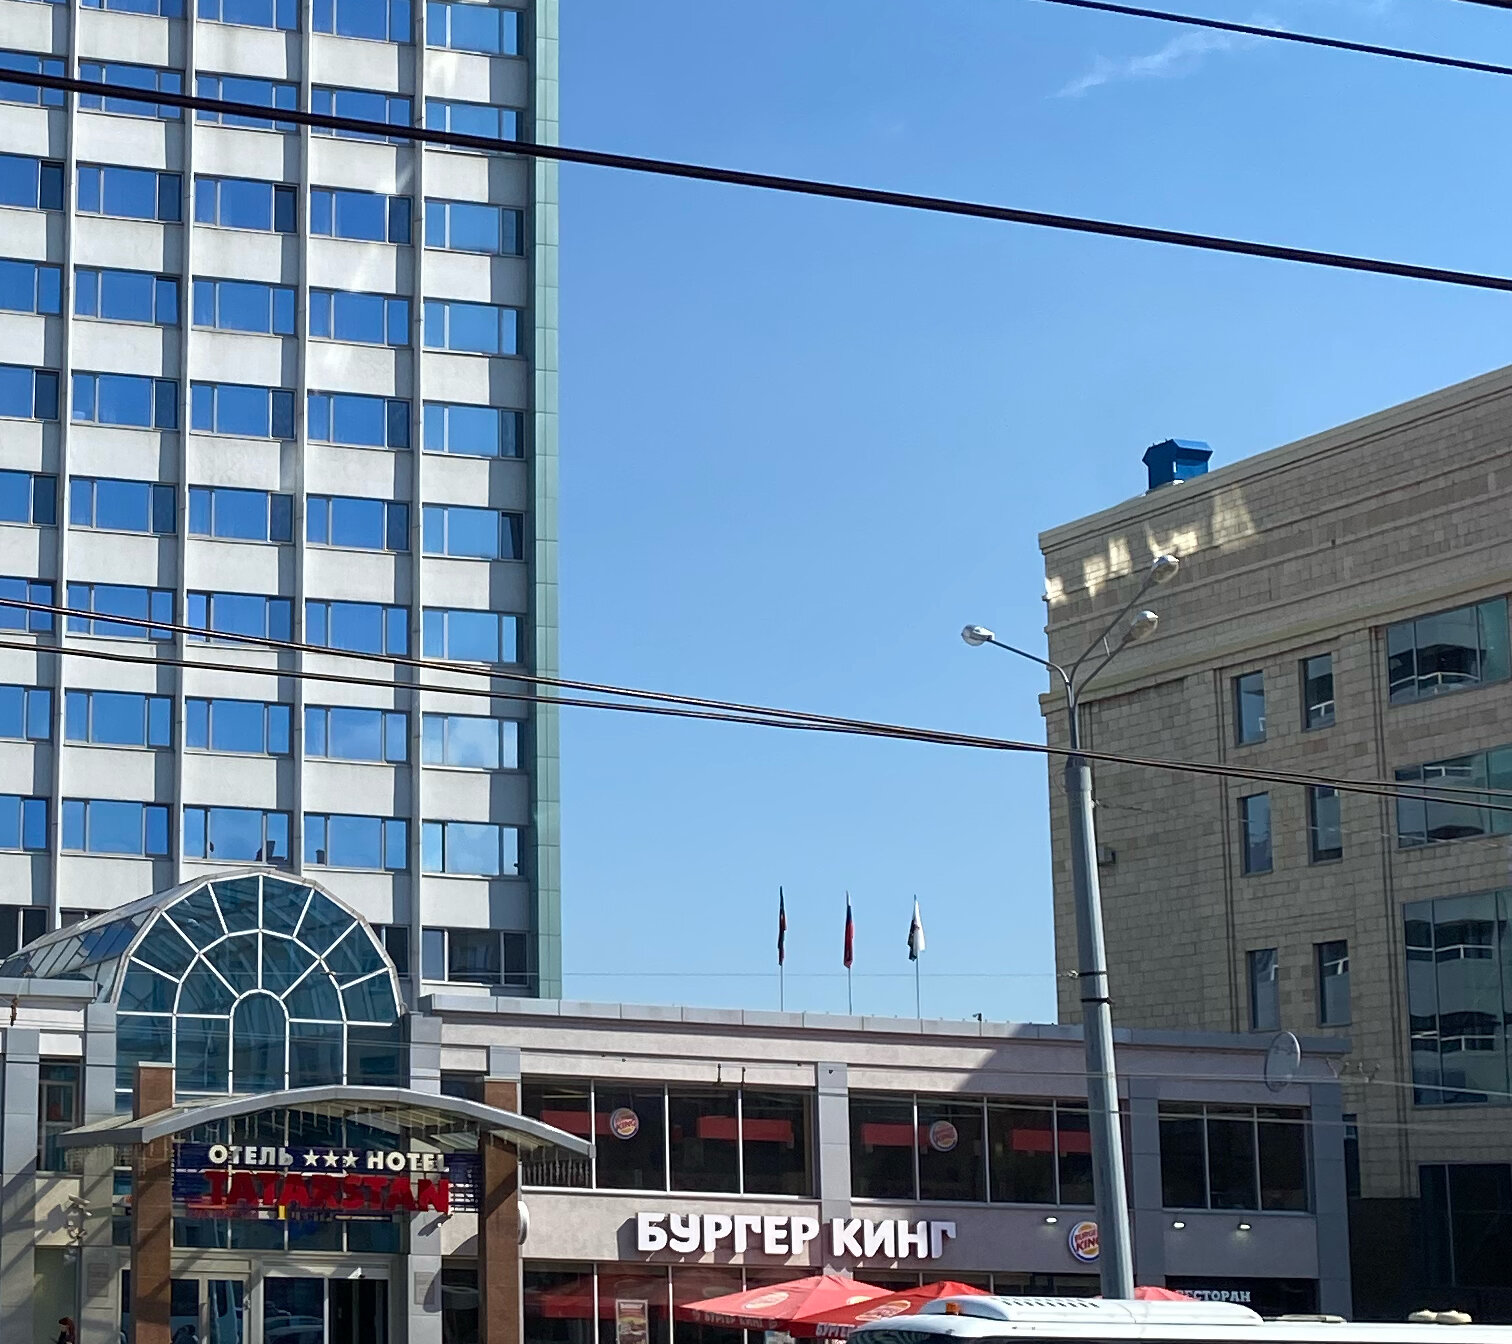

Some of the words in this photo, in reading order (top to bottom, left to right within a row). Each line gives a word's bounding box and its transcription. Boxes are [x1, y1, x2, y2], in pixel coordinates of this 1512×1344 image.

[208, 1144, 294, 1166] ОТЕЛЬ
[366, 1150, 449, 1172] HOTEL
[205, 1170, 450, 1214] TATARSTAN
[637, 1212, 820, 1255] БУРГЕР
[832, 1217, 957, 1259] КИНГ
[815, 1321, 850, 1338] БУРГЕ
